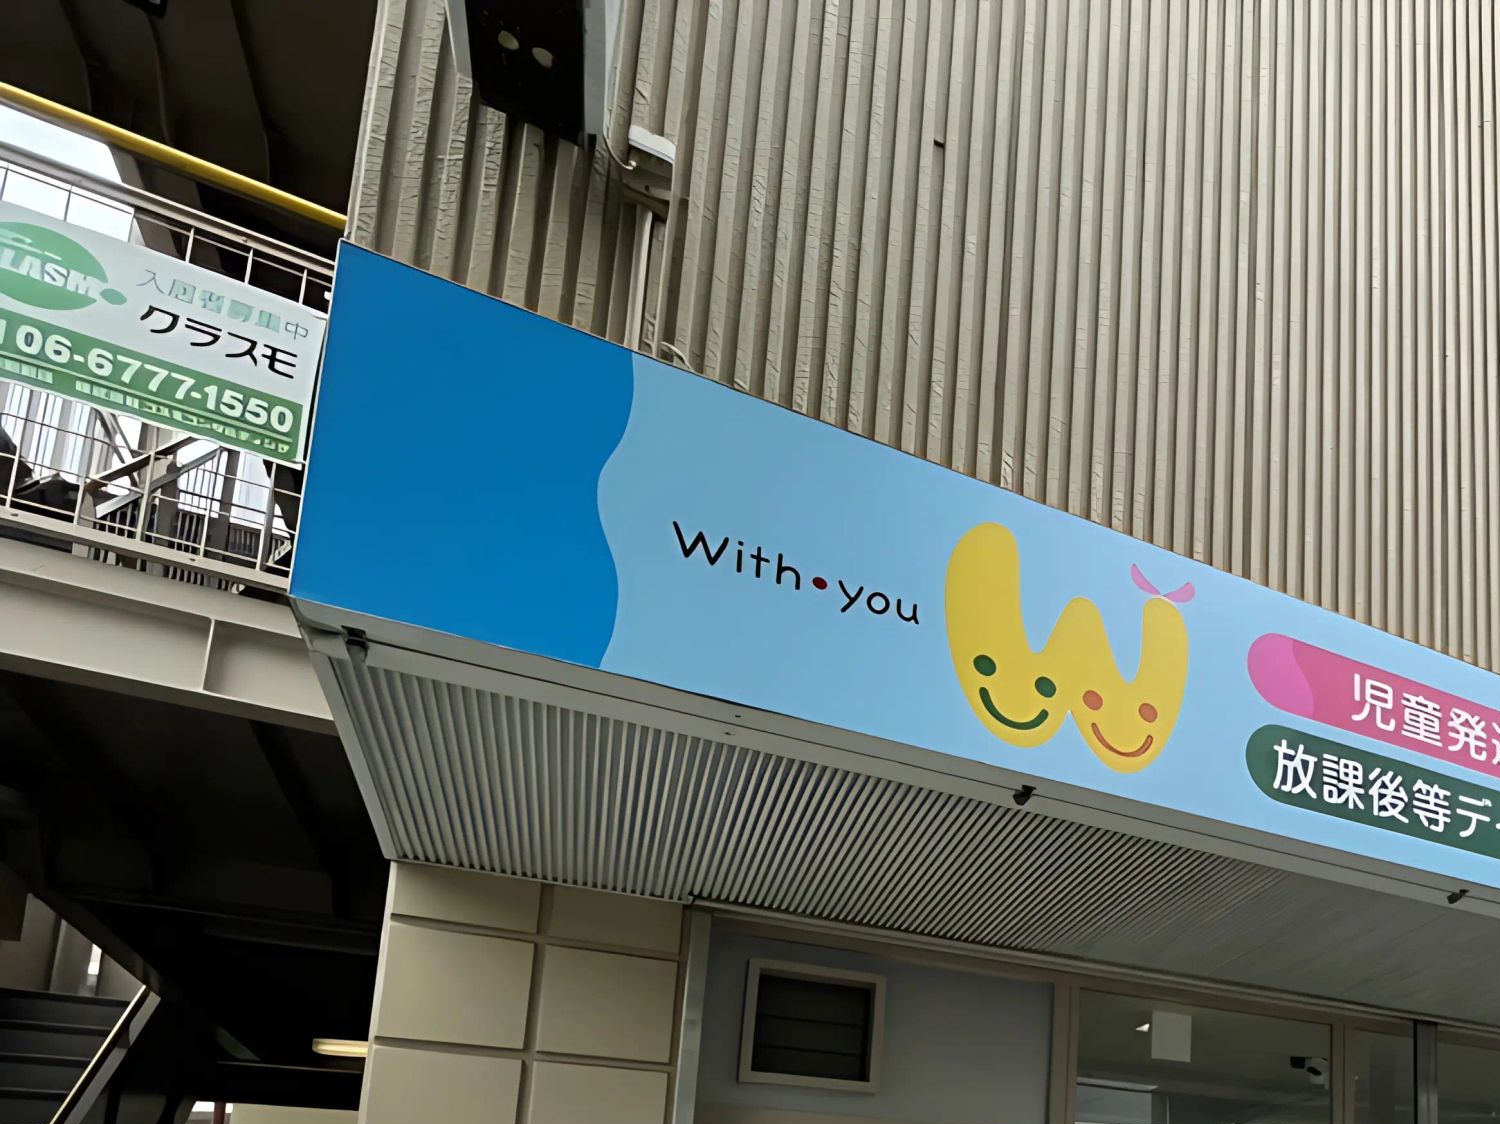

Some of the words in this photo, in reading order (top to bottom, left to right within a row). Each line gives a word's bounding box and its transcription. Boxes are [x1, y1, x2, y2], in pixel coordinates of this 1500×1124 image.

[15, 324, 294, 433] 06-6777-1550
[140, 305, 298, 379] クラスモ
